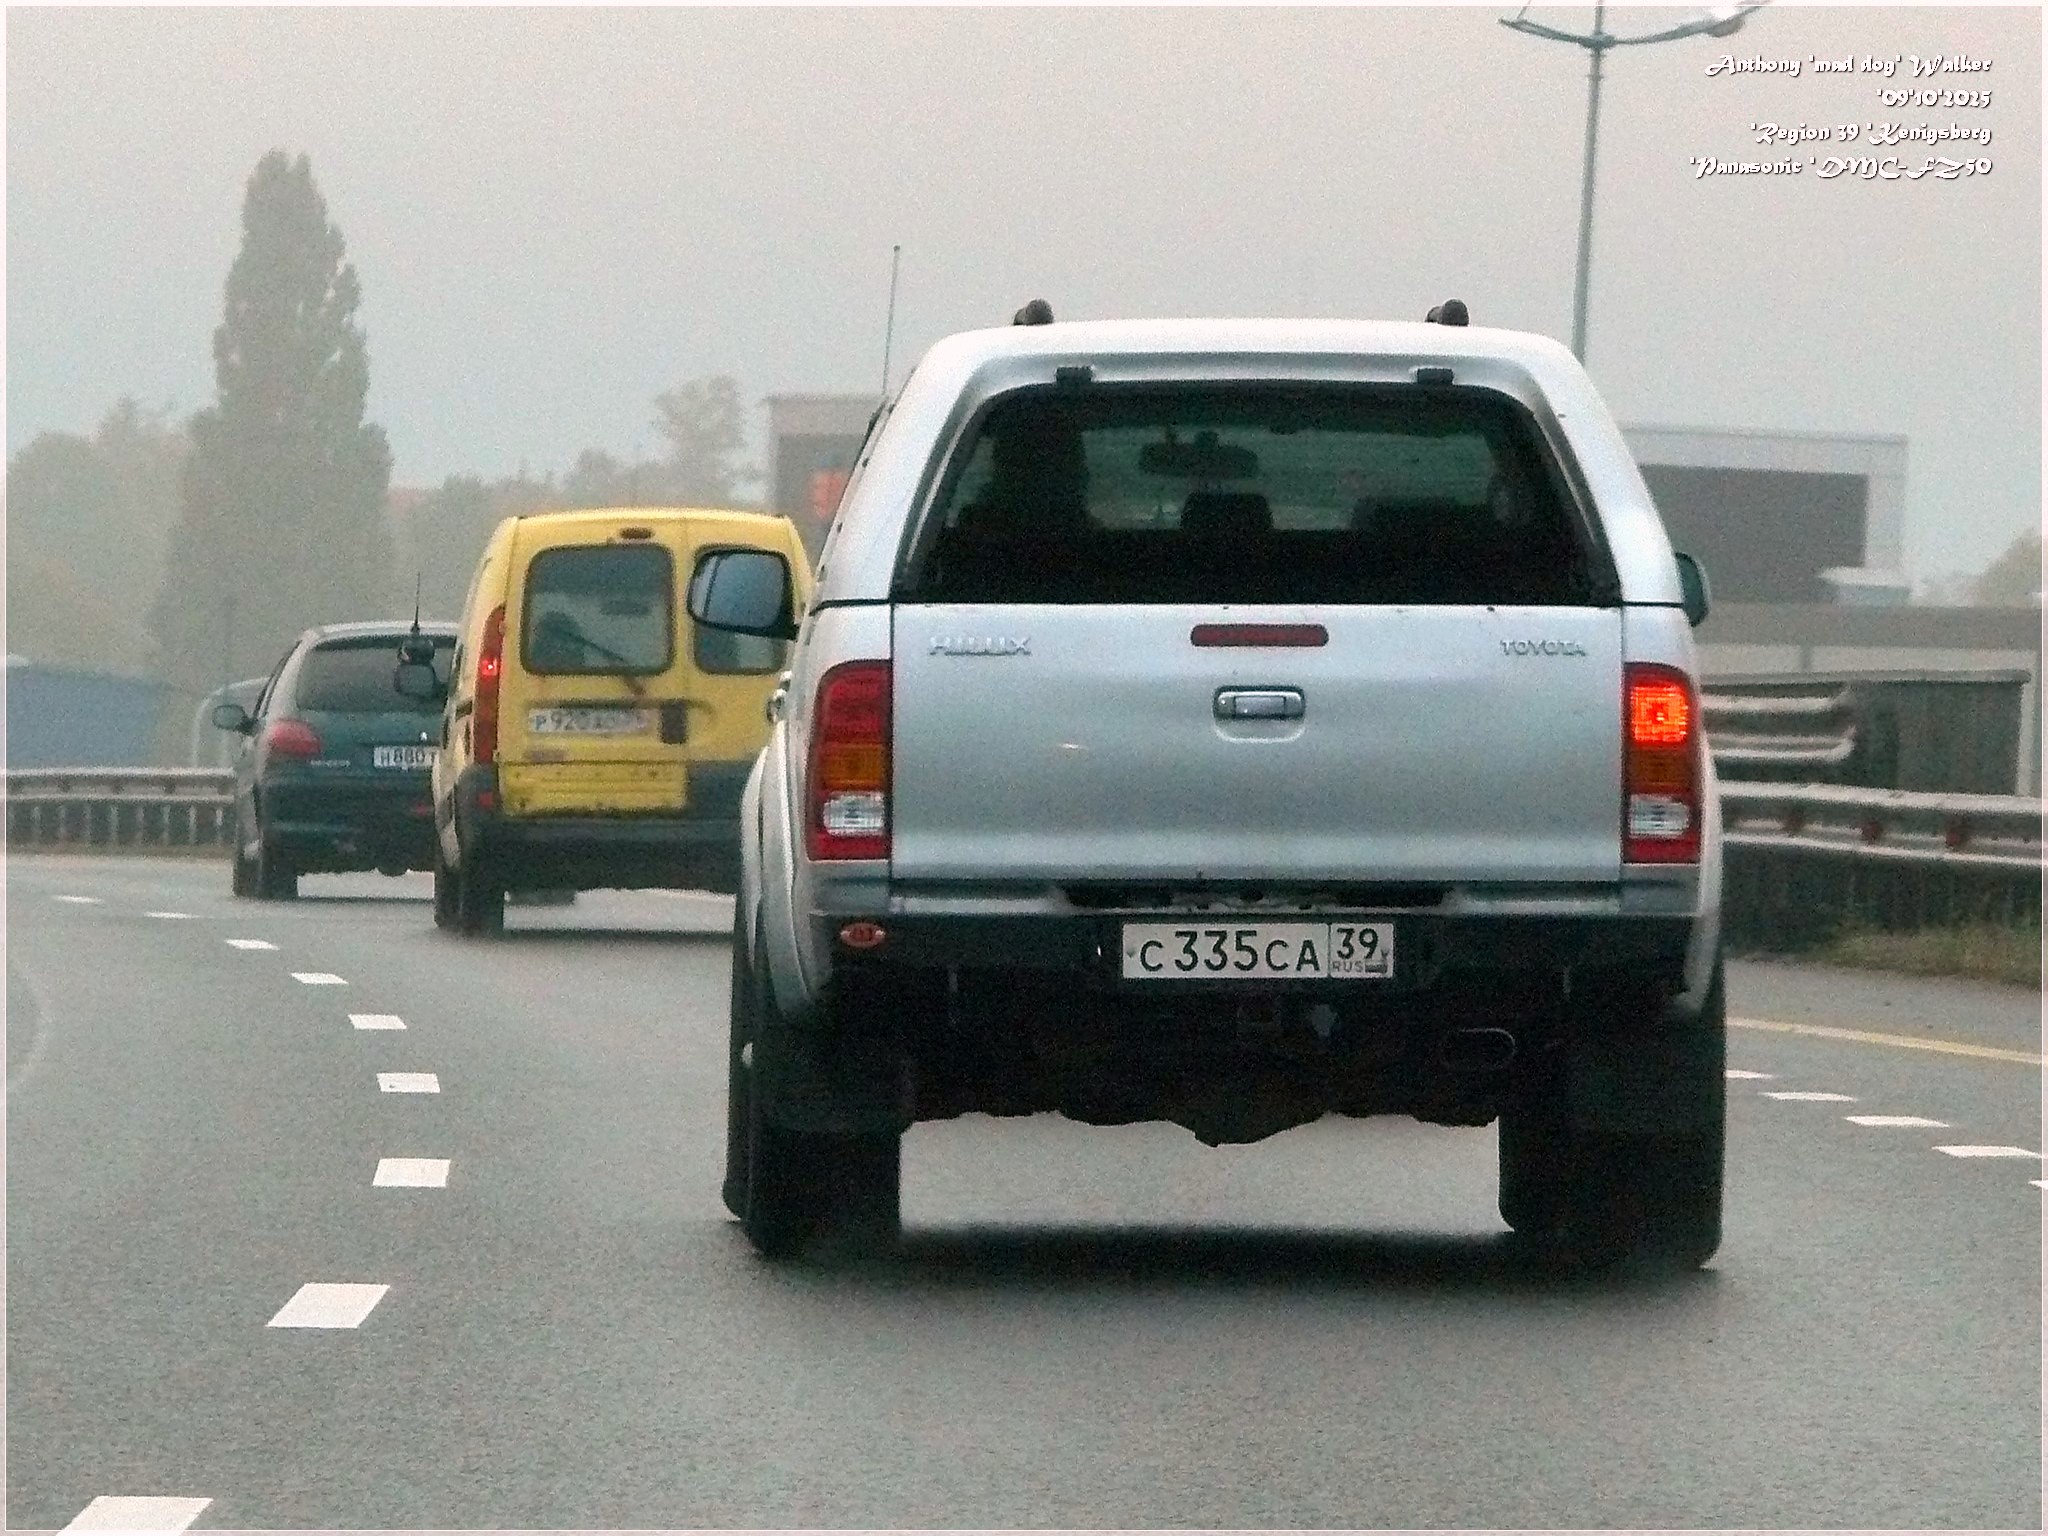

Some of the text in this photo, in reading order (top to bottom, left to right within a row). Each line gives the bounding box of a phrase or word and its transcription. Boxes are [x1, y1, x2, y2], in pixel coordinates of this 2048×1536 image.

[1500, 640, 1586, 657] TOYOTA
[1139, 928, 1379, 971] C335CA 39
[1332, 960, 1364, 973] RUS
